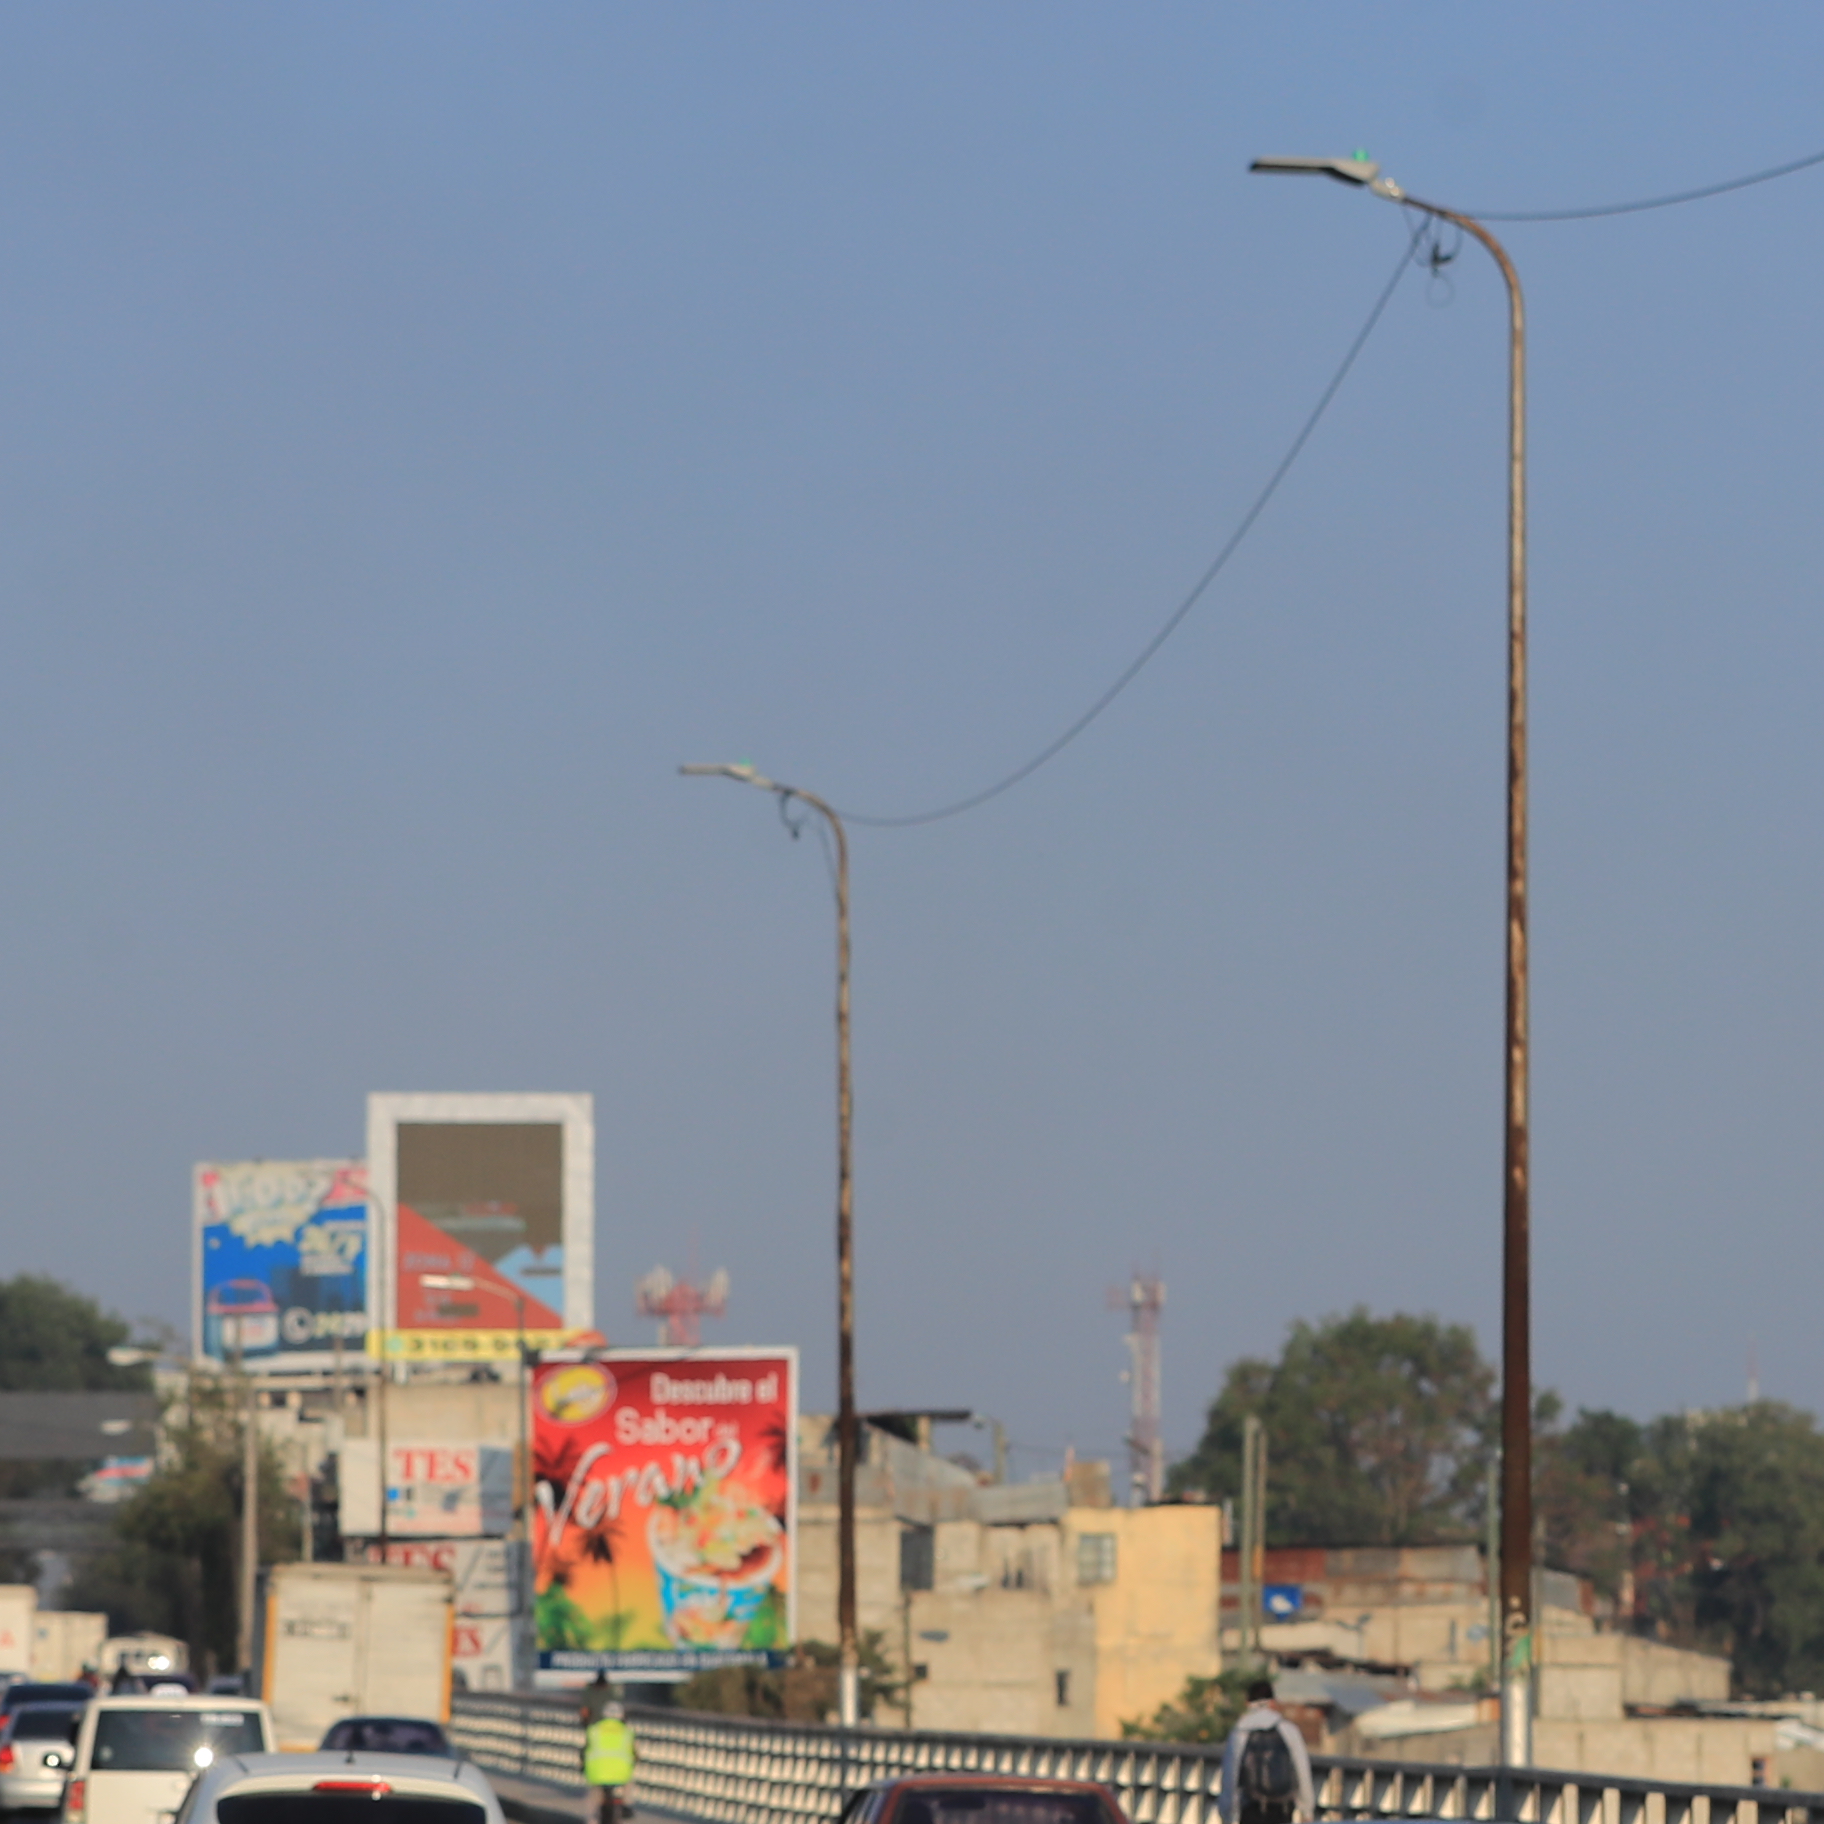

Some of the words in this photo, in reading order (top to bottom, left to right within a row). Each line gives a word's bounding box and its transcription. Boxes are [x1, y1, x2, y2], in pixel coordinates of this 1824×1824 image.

[650, 1371, 753, 1405] Descubre
[755, 1371, 780, 1404] el
[614, 1406, 714, 1446] Sabor
[534, 1441, 742, 1547] Verano
